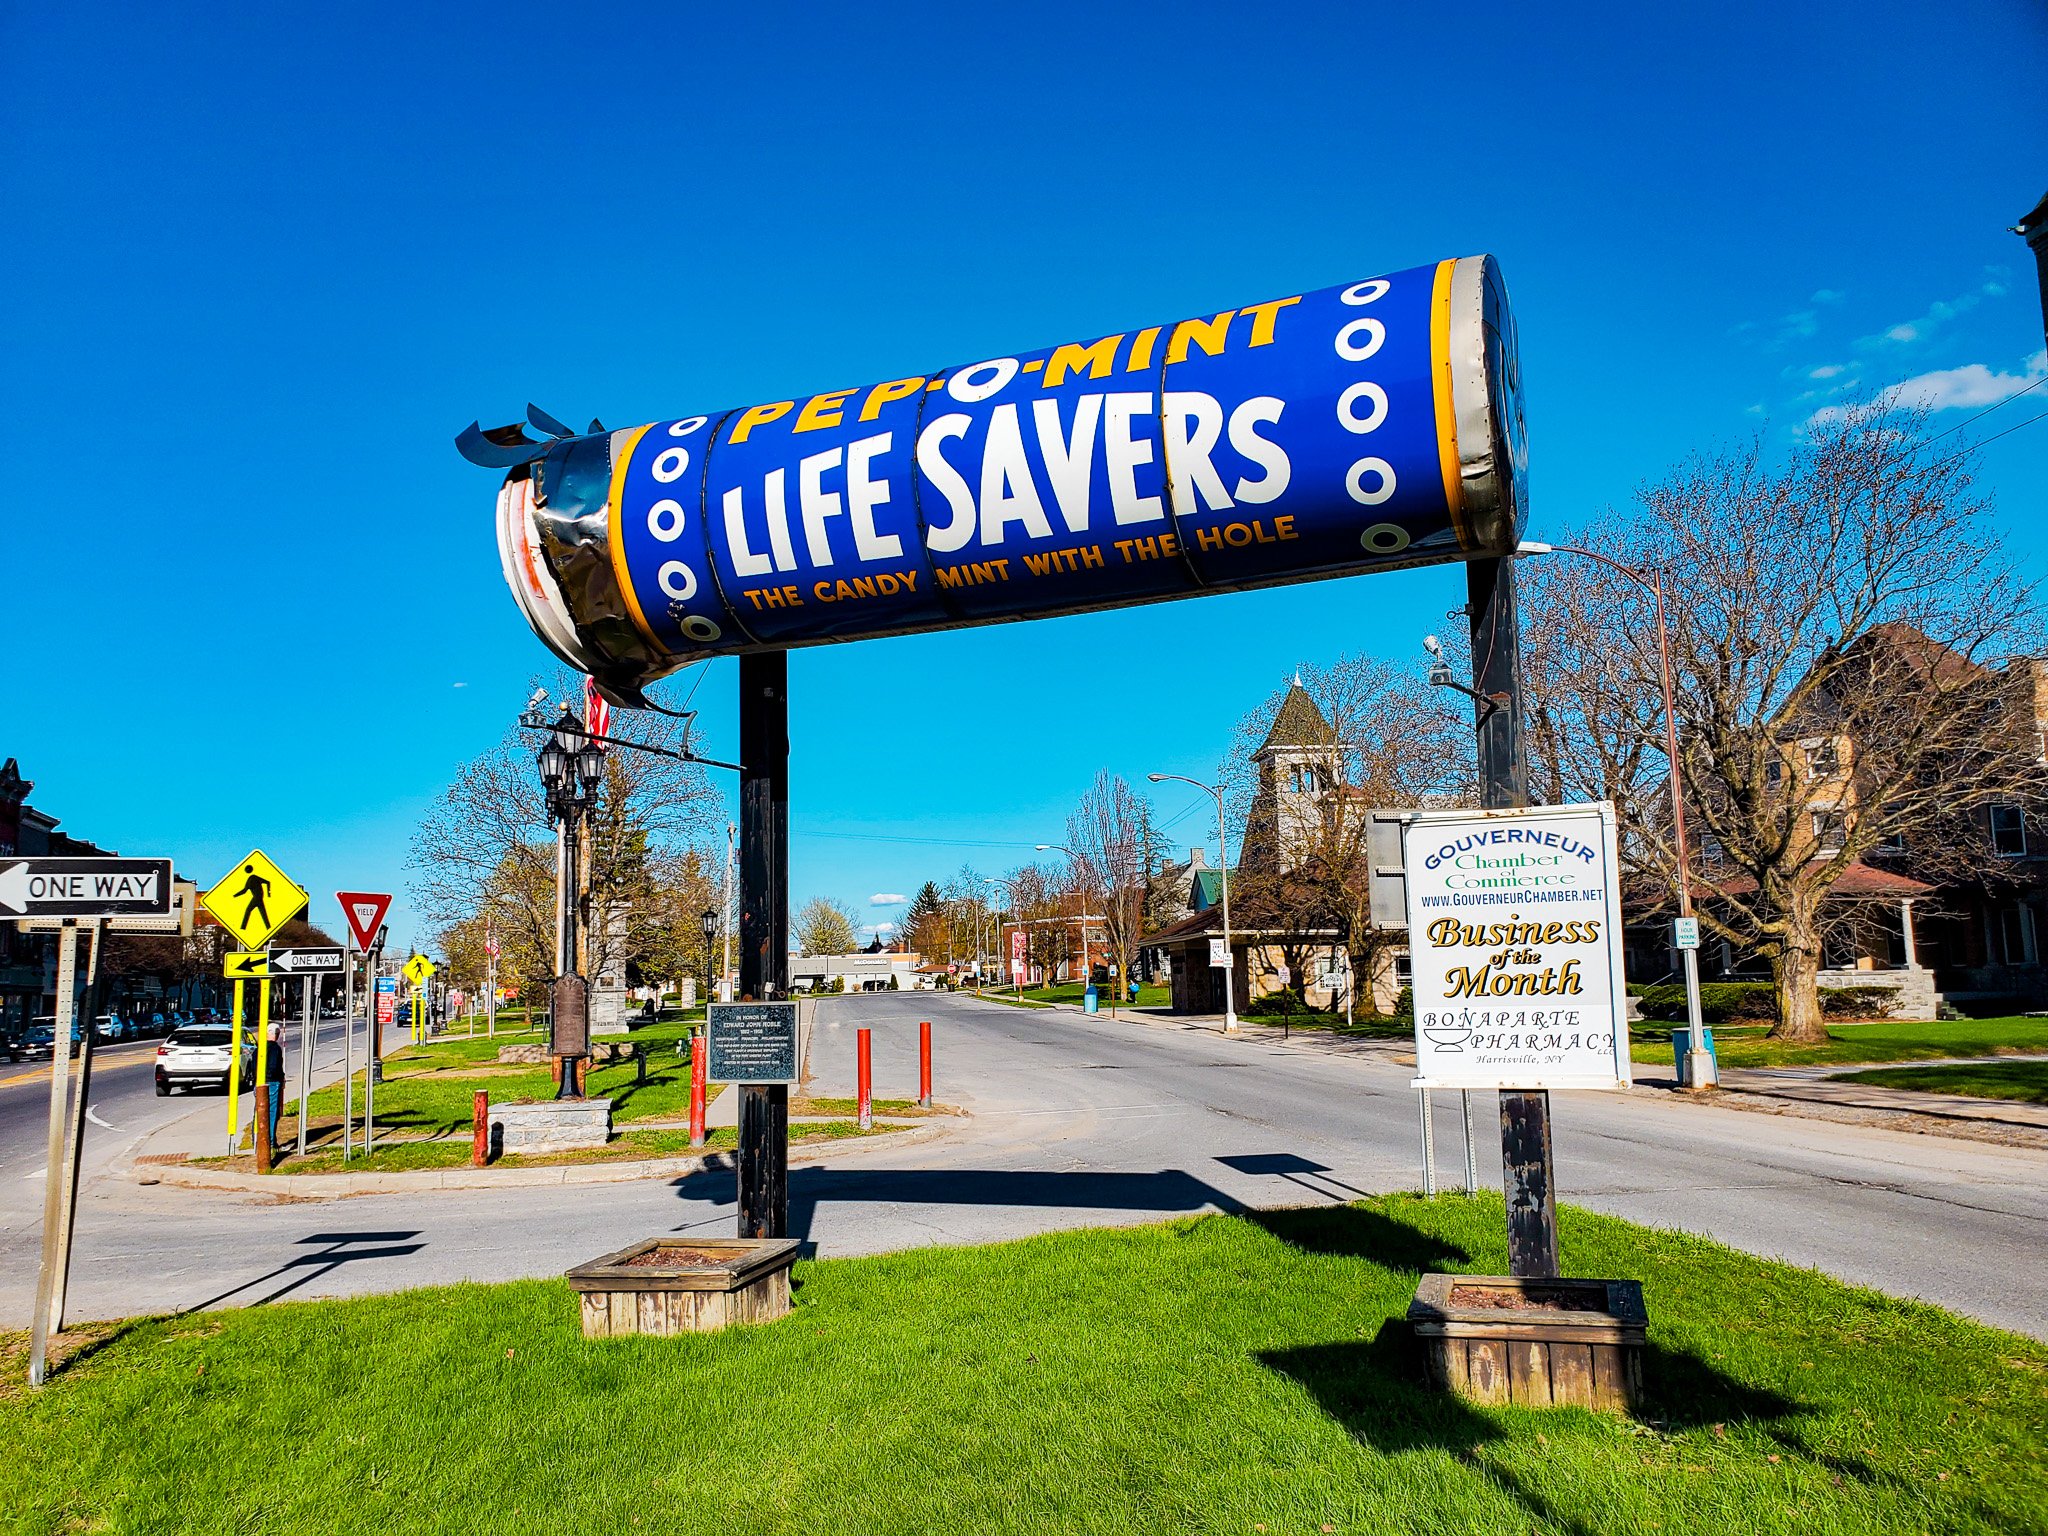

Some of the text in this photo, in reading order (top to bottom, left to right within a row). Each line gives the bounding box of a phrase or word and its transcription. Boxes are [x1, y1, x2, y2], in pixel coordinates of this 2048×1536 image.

[722, 391, 1292, 578] LIFE SAVERS
[743, 515, 1299, 611] THE CANDY MINT WITH THE HOLE
[1424, 828, 1596, 871] GOUVERNEUR
[1455, 852, 1563, 870] Chamber
[1445, 873, 1576, 890] Commerce
[1500, 868, 1518, 877] of
[29, 876, 152, 898] ONE WAY
[356, 907, 374, 916] YIELD
[1426, 913, 1602, 947] Business
[291, 955, 338, 966] ONE WAY
[1489, 948, 1542, 970] of the
[1443, 959, 1584, 999] Month
[1423, 1009, 1580, 1030] BONAPARTE
[1470, 1032, 1615, 1051] PHARMACY
[1475, 1054, 1566, 1065] Harrisville, NY
